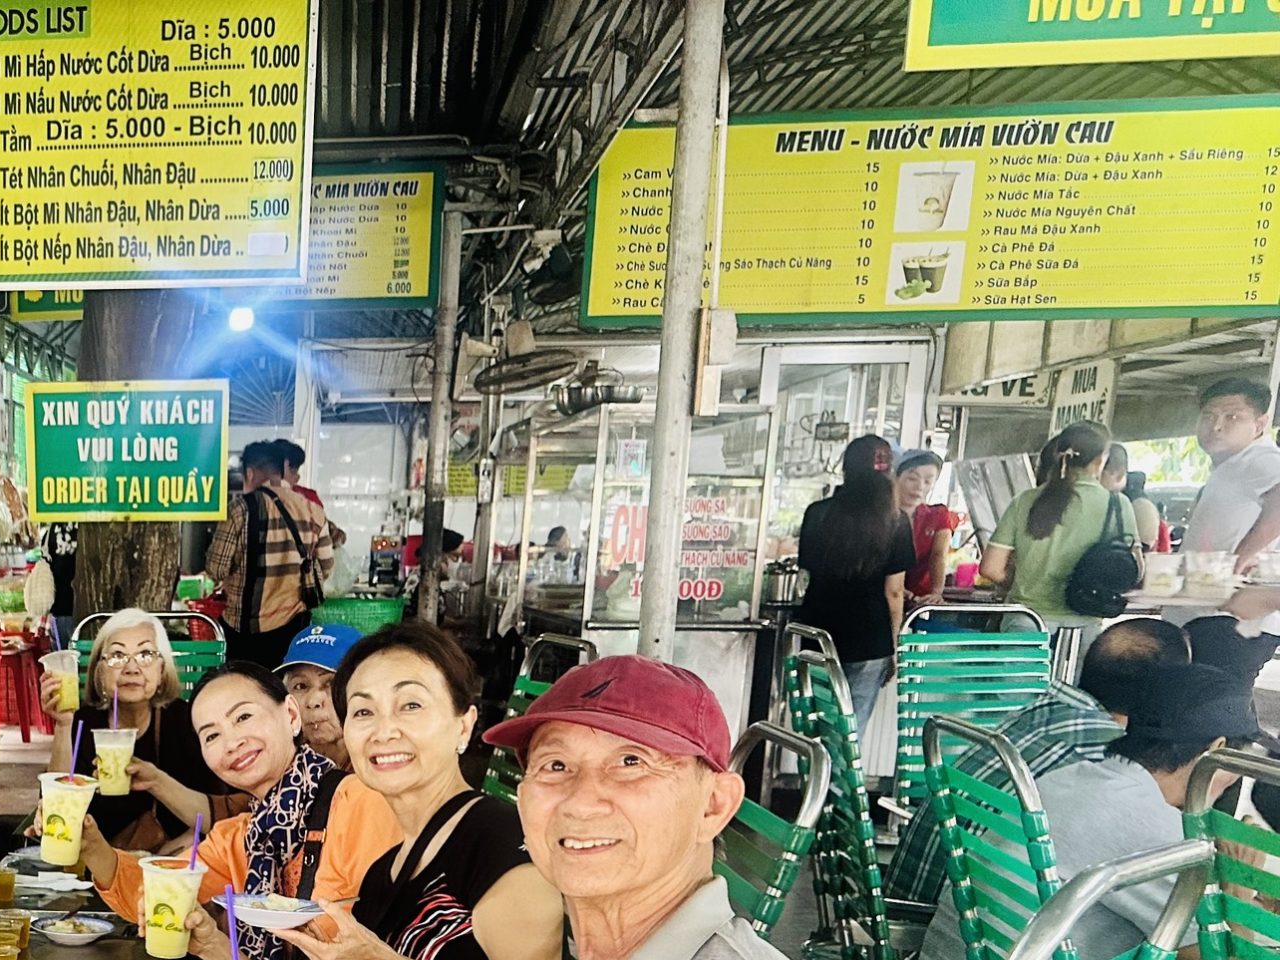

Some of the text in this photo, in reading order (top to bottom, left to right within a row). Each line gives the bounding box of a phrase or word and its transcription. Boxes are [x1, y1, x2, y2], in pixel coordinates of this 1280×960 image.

[46, 6, 87, 33] LIST
[161, 17, 275, 42] Dĩa 5.000
[5, 53, 22, 78] Mì
[26, 49, 55, 81] Hấp
[60, 51, 102, 76] Nước
[106, 46, 134, 74] Cốt
[138, 48, 170, 73] Dừa
[190, 43, 232, 68] Bịch
[250, 44, 301, 69] 10.000
[0, 125, 32, 153] Tằm
[247, 121, 297, 145] 10.000
[47, 115, 241, 146] Dĩa 5.000 Bịch
[775, 119, 1115, 154] MENU NƯỚC MÍA VƯỜN CAU
[1002, 153, 1033, 166] Nước
[1037, 152, 1062, 165] Mía:
[1066, 152, 1090, 164] Dừa
[1105, 151, 1129, 164] Đậu
[1133, 151, 1164, 163] Xanh
[1207, 148, 1244, 161] Riêng
[1267, 146, 1280, 158] 15
[0, 164, 24, 189] Tét
[27, 164, 65, 188] Nhân
[70, 159, 117, 190] Chuối,
[122, 161, 161, 186] Nhân
[166, 161, 196, 193] Đậu
[634, 162, 880, 180] Cam 15
[393, 180, 419, 197] CAU
[633, 181, 878, 199] Chanh 10
[0, 196, 11, 224] Ít
[13, 200, 39, 230] Bột
[43, 199, 61, 223] Mì
[65, 200, 102, 223] Nhân
[107, 199, 142, 228] Đậu,
[145, 198, 184, 222] Nhân
[189, 197, 220, 220] Dừa
[248, 198, 290, 219] 5.000
[996, 201, 1273, 219] Nước Mía Nguyên Chất 10
[756, 257, 786, 271] Thạch
[856, 256, 870, 268] 10
[386, 281, 412, 295] 6.000
[1011, 294, 1032, 306] Hạt
[1035, 294, 1057, 304] Sen
[1244, 290, 1258, 301] 15
[1071, 366, 1098, 395] MUA
[42, 395, 215, 429] XIN QUÝ KHÁCH
[78, 432, 179, 462] VUI LÒNG
[42, 476, 108, 504] ORDER
[116, 476, 151, 509] TẠI
[611, 504, 648, 564] CH
